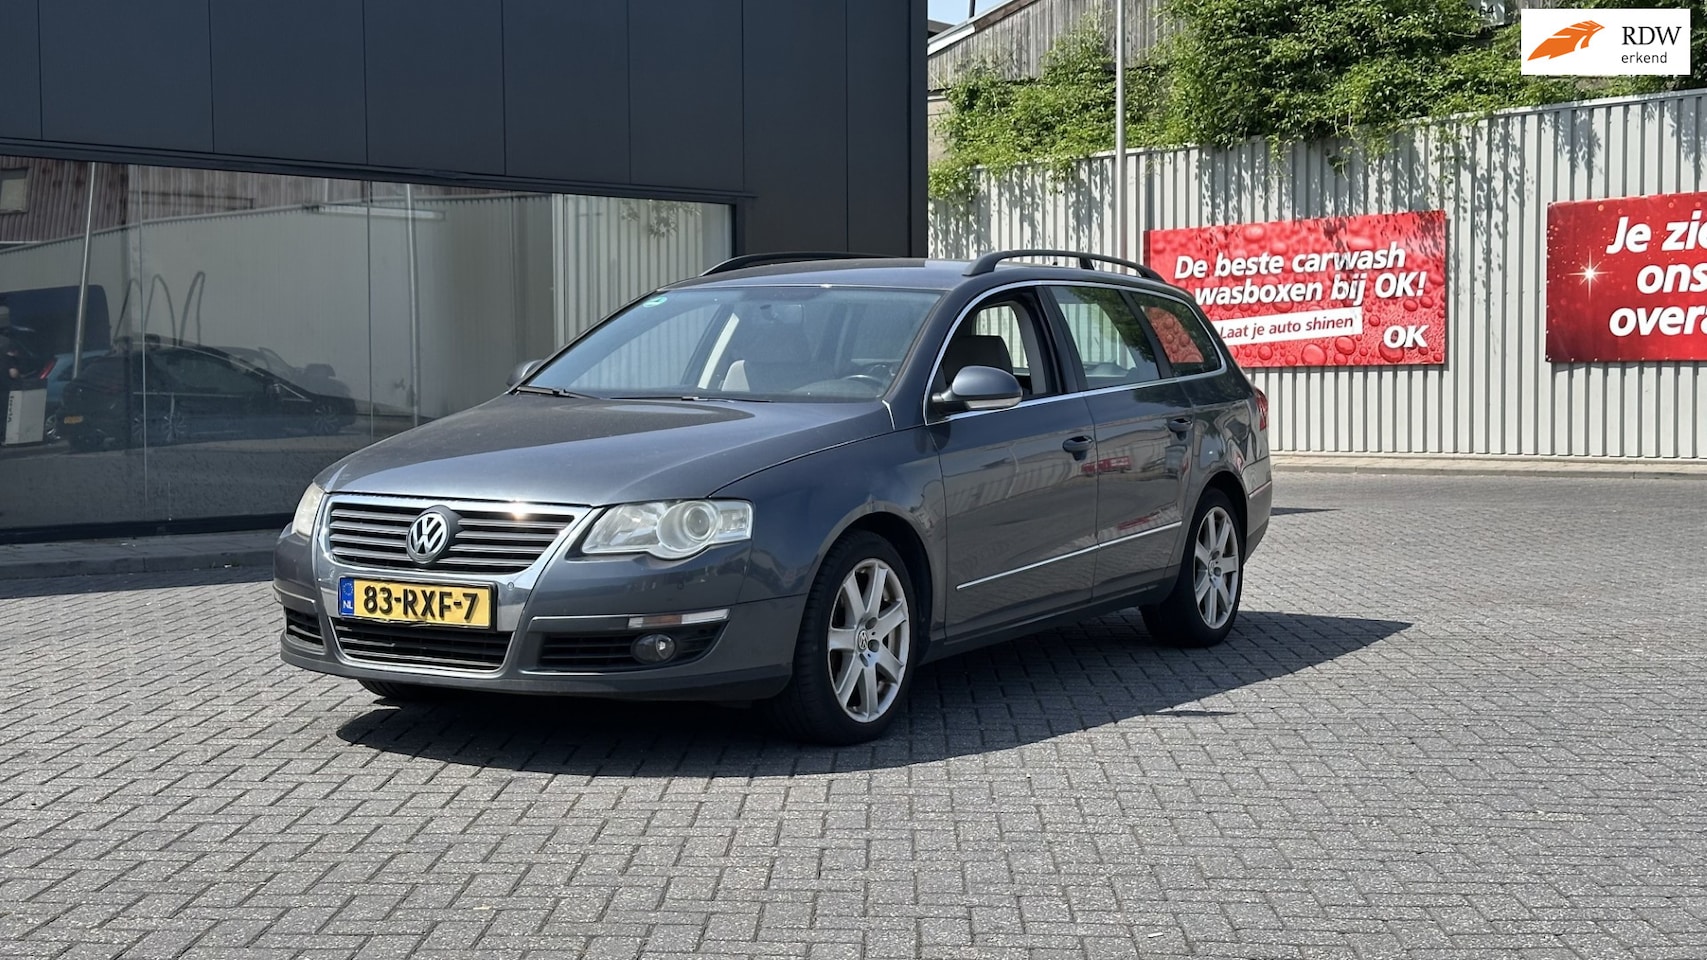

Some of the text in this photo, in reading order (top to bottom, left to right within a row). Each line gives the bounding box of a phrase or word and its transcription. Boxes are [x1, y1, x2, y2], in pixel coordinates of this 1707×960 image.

[1606, 216, 1651, 254] Je
[1175, 241, 1405, 279] De beste carwash
[1195, 271, 1427, 306] wasboxen bij OK!
[1219, 315, 1353, 341] Laat je auto shinen
[1382, 325, 1429, 349] OK
[1609, 305, 1707, 337] over
[343, 600, 353, 609] NL
[363, 585, 479, 621] 83-RXF-7
